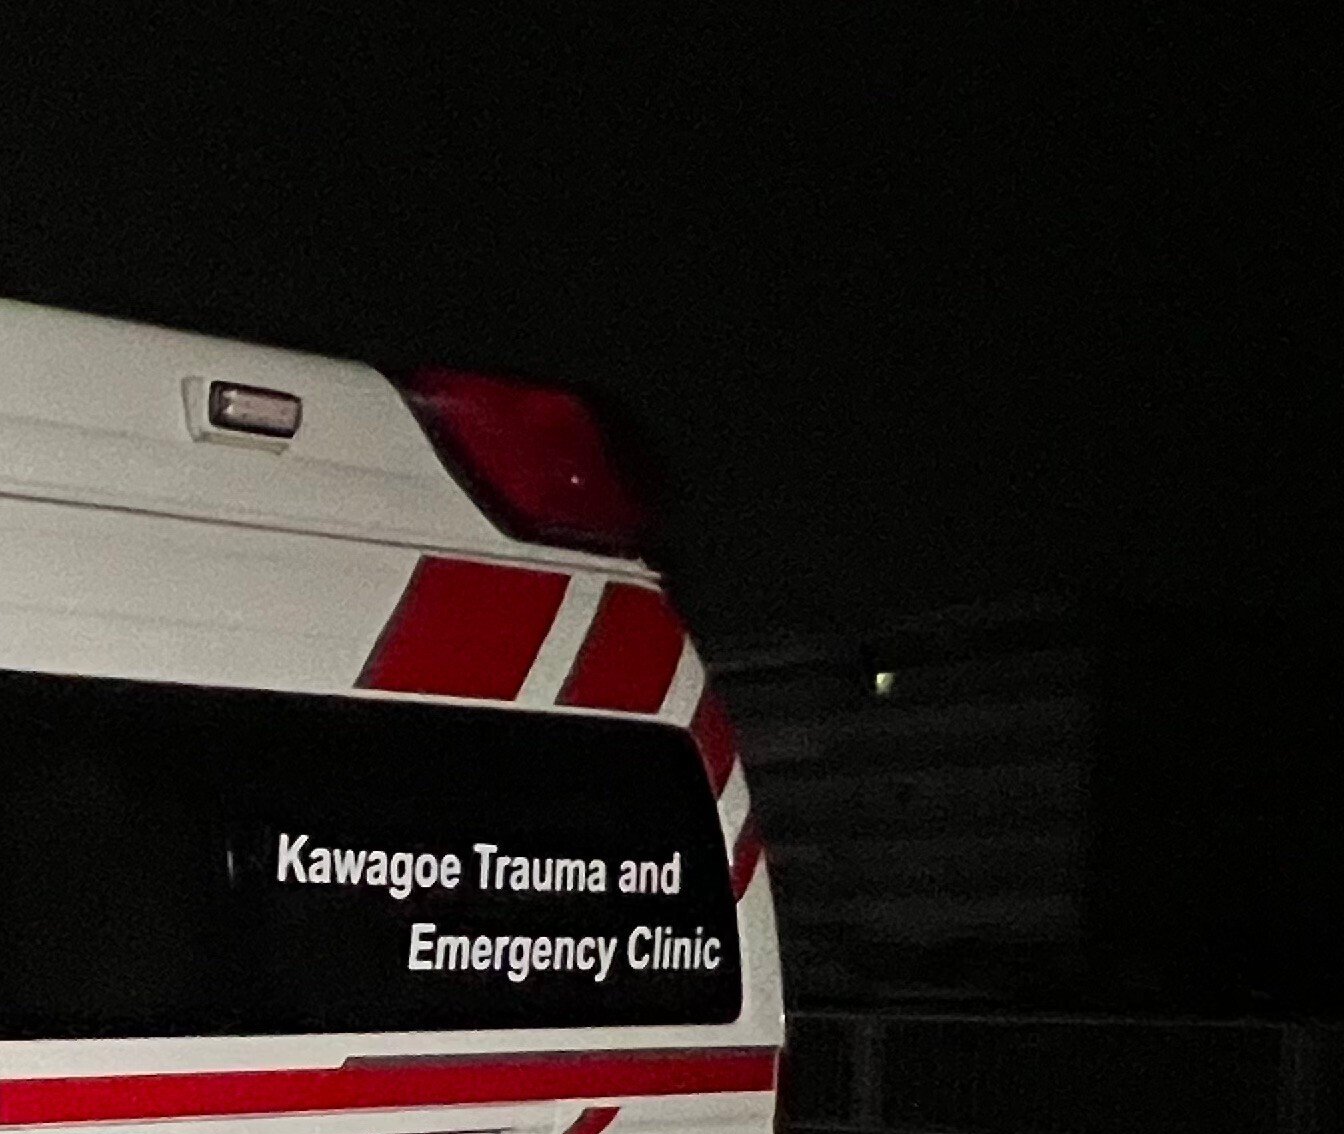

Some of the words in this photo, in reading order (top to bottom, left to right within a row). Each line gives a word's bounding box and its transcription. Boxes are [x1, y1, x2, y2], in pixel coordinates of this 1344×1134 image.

[277, 832, 462, 900] Kawagoe
[472, 842, 607, 893] Trauma
[618, 850, 682, 896] and
[407, 922, 618, 983] Emergency
[626, 925, 722, 971] Clinic
